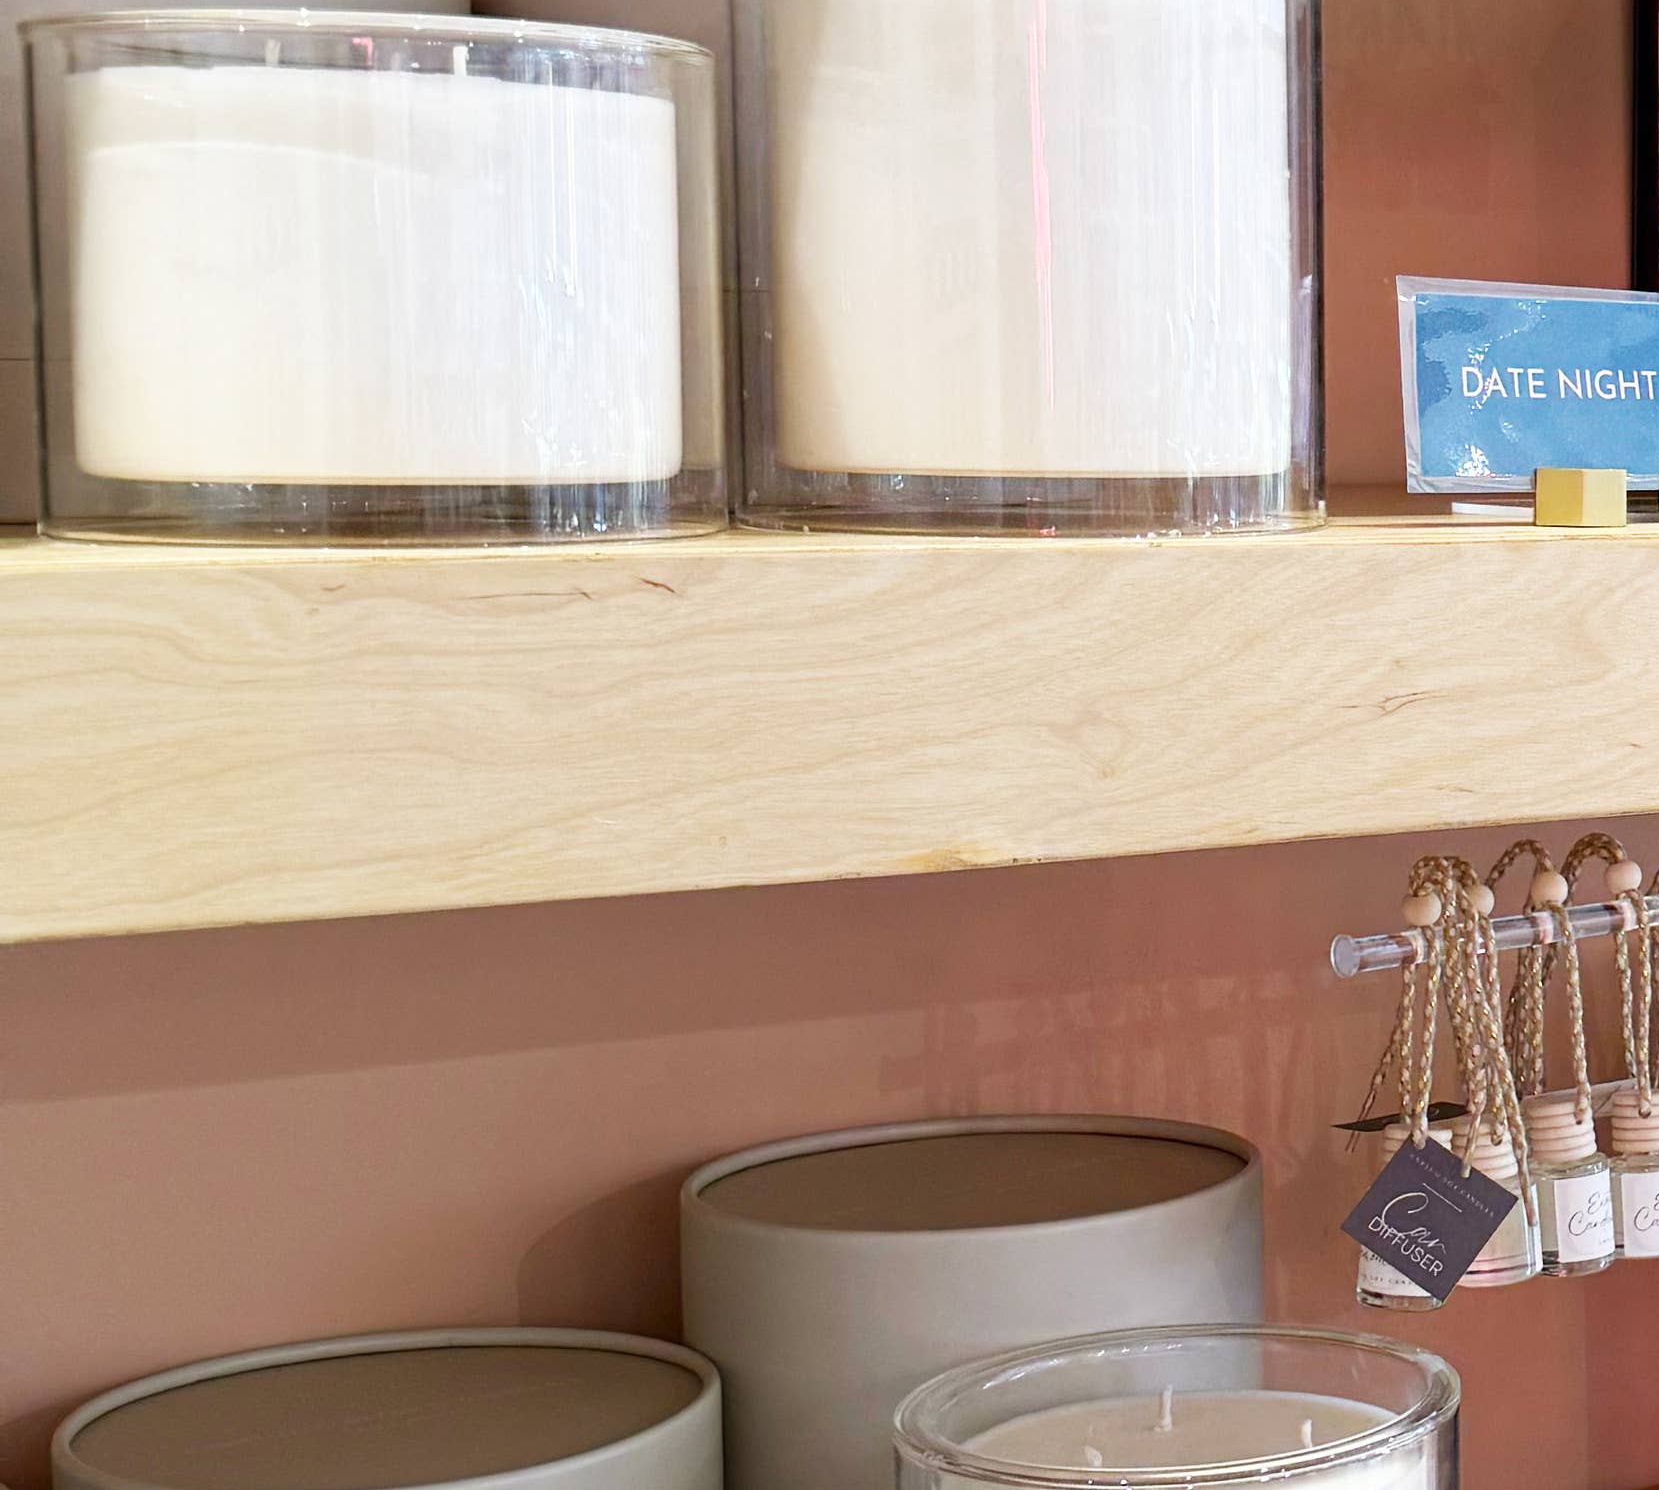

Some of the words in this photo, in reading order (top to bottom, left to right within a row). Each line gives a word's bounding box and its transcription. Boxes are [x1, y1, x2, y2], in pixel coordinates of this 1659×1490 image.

[1460, 366, 1547, 399] DATE
[1557, 368, 1658, 400] NIGHT
[1367, 1215, 1444, 1277] DIFFUSER
[1381, 1191, 1448, 1255] Car
